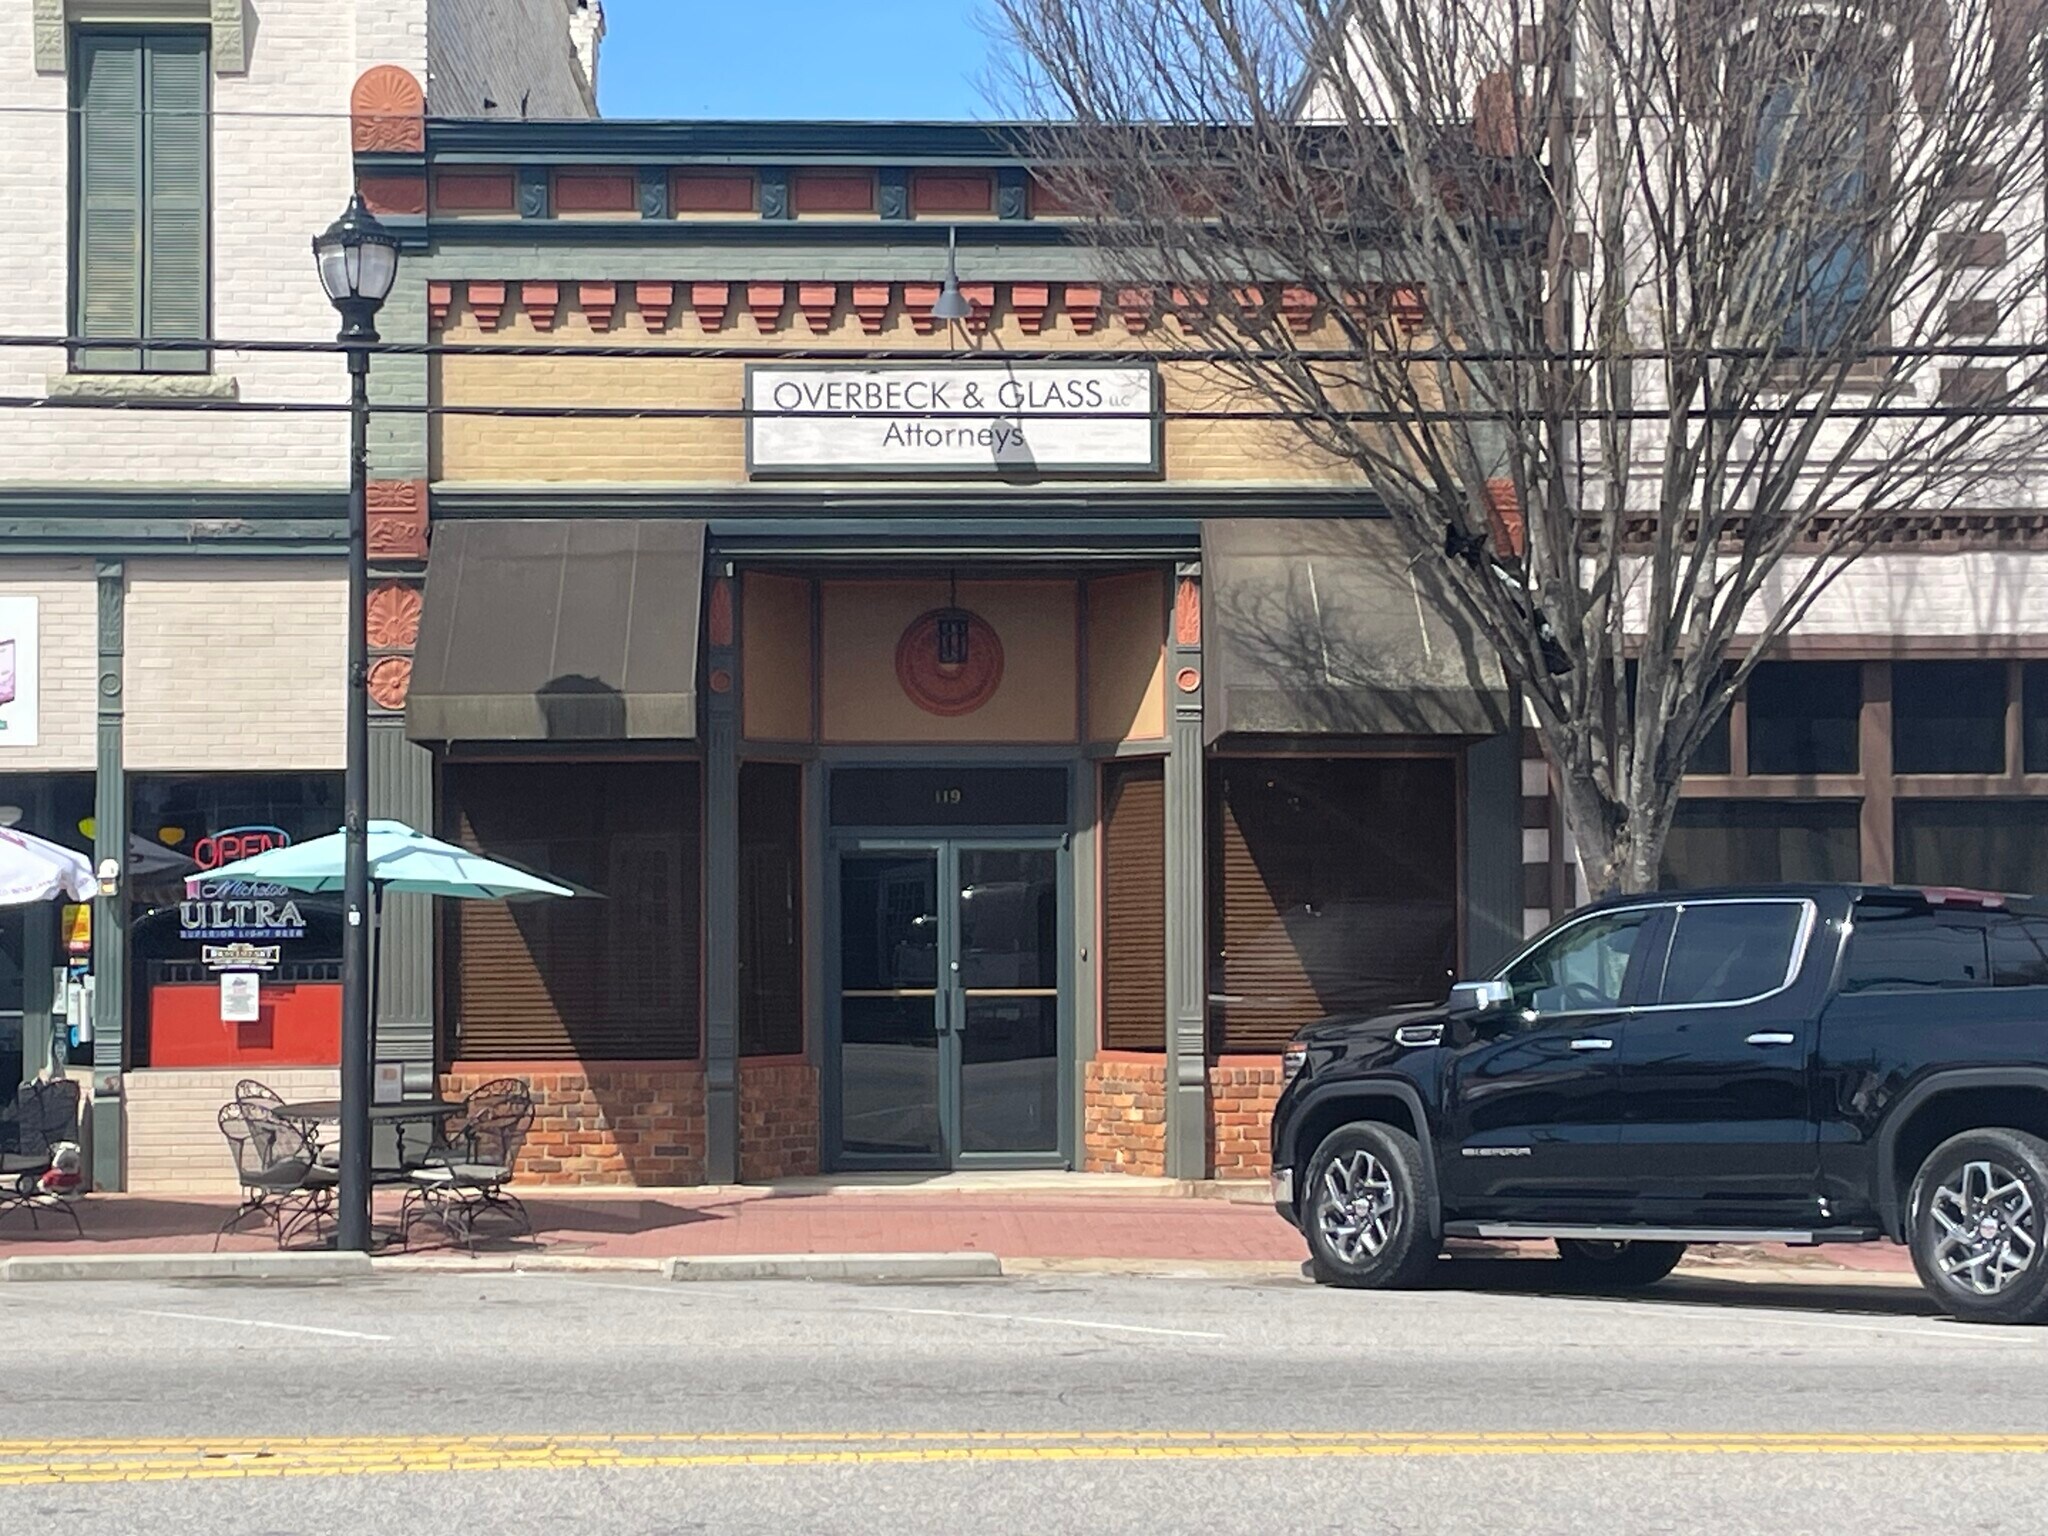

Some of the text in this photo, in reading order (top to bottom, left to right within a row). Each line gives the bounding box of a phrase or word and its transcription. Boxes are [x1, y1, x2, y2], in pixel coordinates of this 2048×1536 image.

[773, 381, 952, 410] OVERBECK
[963, 381, 985, 408] &
[998, 380, 1103, 408] GLASS
[882, 421, 1025, 453] Attorneys
[935, 789, 961, 804] 119
[179, 900, 306, 929] ULTRA
